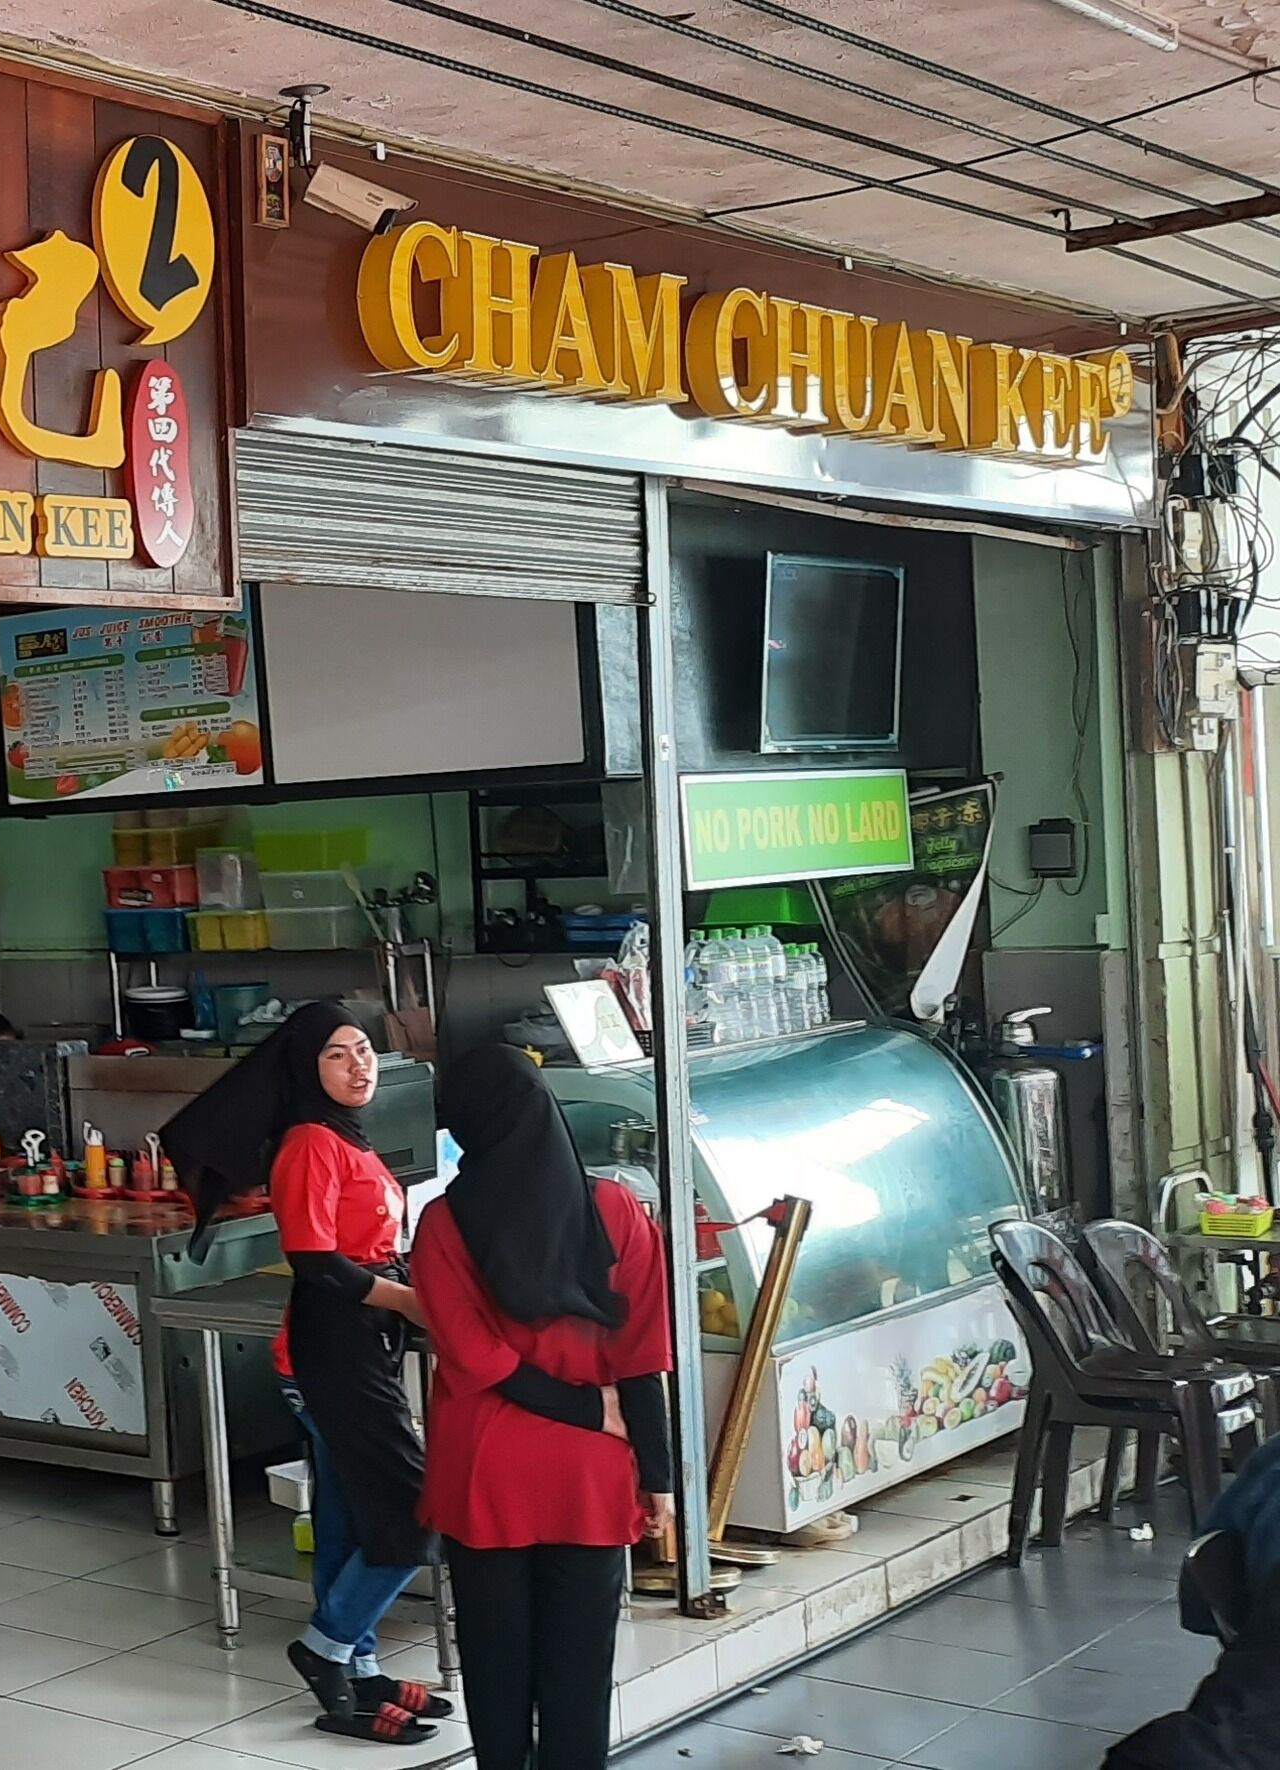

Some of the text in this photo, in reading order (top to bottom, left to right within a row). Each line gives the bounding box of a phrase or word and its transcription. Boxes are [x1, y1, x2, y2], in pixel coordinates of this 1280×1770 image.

[372, 220, 689, 403] CHAM
[708, 288, 972, 451] CHUAN
[991, 344, 1111, 465] KEE
[50, 504, 129, 550] KEE
[100, 620, 130, 635] JUICE
[138, 611, 193, 629] SMOOTHIE
[694, 799, 901, 854] NO PORK NO LARD
